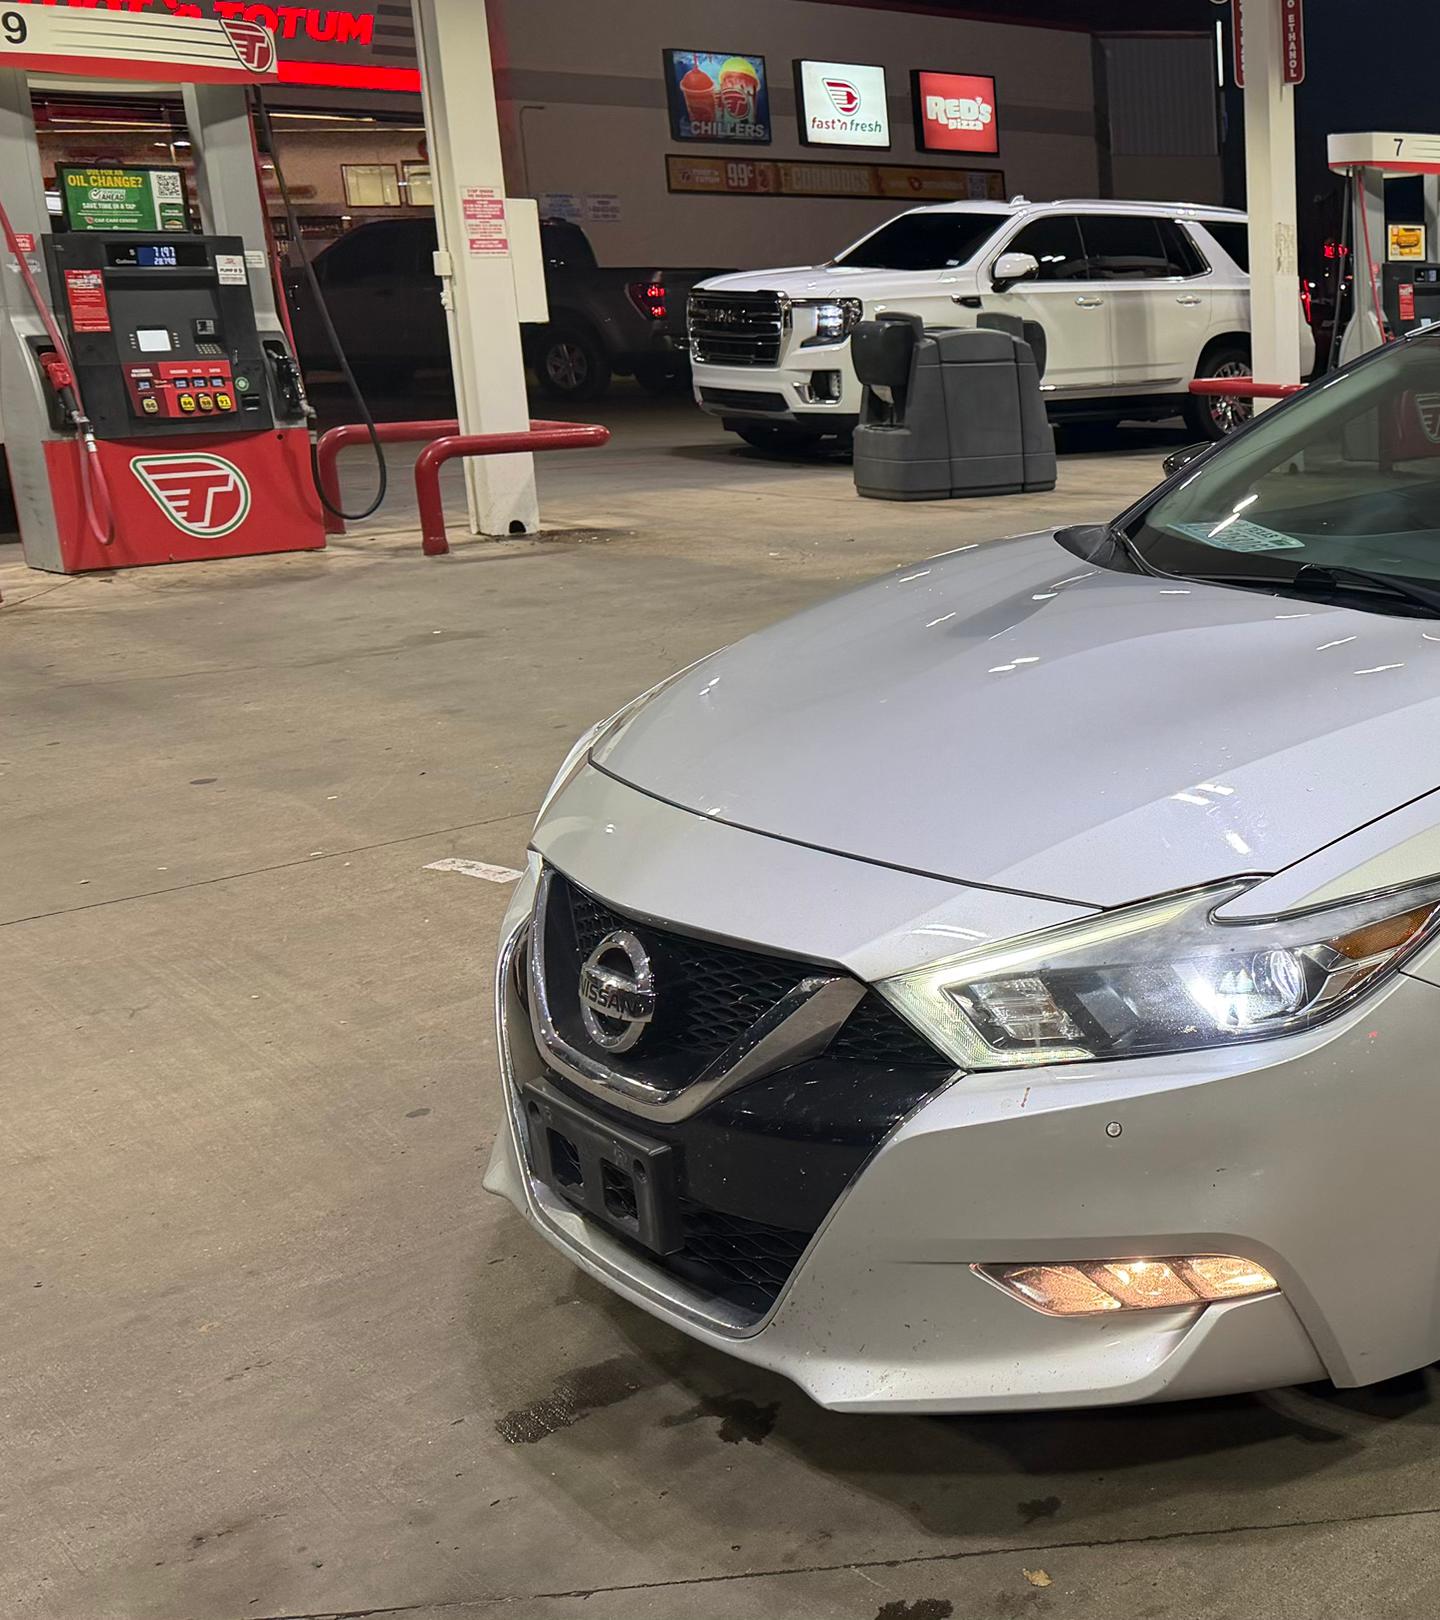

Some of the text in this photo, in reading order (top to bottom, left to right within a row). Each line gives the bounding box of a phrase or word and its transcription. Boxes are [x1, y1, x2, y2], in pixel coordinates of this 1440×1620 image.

[1, 11, 28, 45] 9
[1287, 14, 1297, 78] ETHANOL
[690, 120, 765, 137] CHILLERS
[850, 119, 883, 133] fresh
[1393, 138, 1404, 157] 7
[67, 175, 143, 188] OIL CHANGE?
[580, 974, 637, 1012] NISSAN
